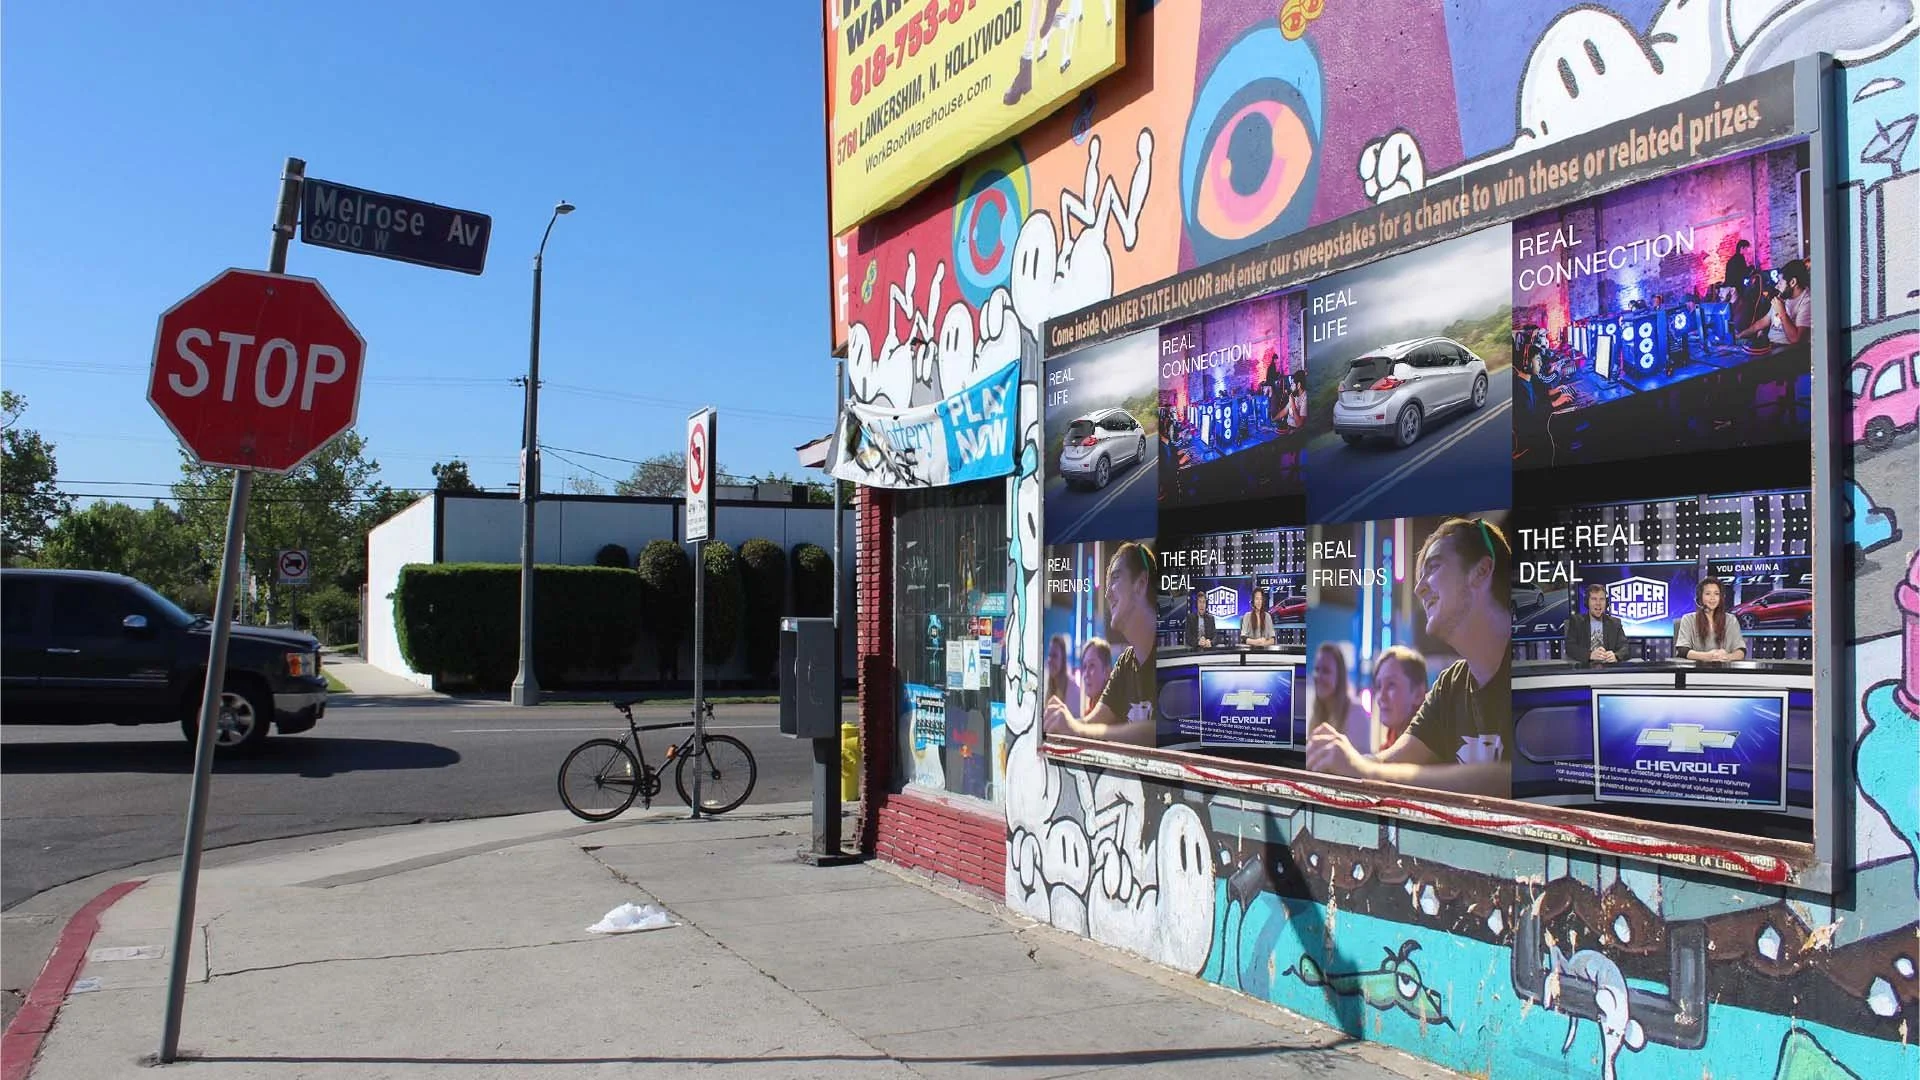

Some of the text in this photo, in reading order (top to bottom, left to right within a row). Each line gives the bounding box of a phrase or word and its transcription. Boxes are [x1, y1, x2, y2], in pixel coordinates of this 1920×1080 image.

[837, 0, 1022, 166] 5760 LANKERSHIM, N. HOLLYWOOD
[865, 73, 992, 174] WorkBootWarehouse.com
[314, 186, 480, 247] Melrose Av
[1051, 99, 1761, 348] Come inside QUAKER STATE LIQUOR and enter our sweepstakes for a chance to win these or related prizes
[310, 219, 390, 251] 6900 W
[1519, 224, 1582, 260] REAL
[1518, 227, 1695, 291] CONNECTION
[1313, 288, 1357, 315] REAL
[1313, 317, 1347, 342] LIFE
[1162, 333, 1195, 357] REAL
[168, 327, 347, 411] STOP
[1162, 341, 1252, 379] CONNECTION
[1049, 368, 1074, 387] REAL
[947, 380, 1011, 427] PLAY
[1048, 389, 1069, 407] LIFE
[954, 417, 1008, 465] NOW
[1518, 523, 1645, 551] THE REAL
[1160, 549, 1226, 568] THE REAL
[1312, 540, 1357, 560] REAL
[1047, 557, 1072, 572] REAL
[1519, 561, 1583, 584] DEAL
[1716, 563, 1780, 573] YOU CAN WIN A
[1047, 578, 1091, 593] FRIENDS
[1161, 574, 1195, 591] DEAL
[1312, 567, 1388, 587] FRIENDS
[1208, 592, 1236, 605] SUPER
[1610, 581, 1664, 603] SUPER
[1208, 604, 1236, 615] LEAGUE
[1610, 602, 1665, 619] LEAGUE
[1220, 715, 1273, 725] CHEVROLET
[1635, 759, 1741, 776] CHEVROLET
[1524, 827, 1558, 840] Melrose
